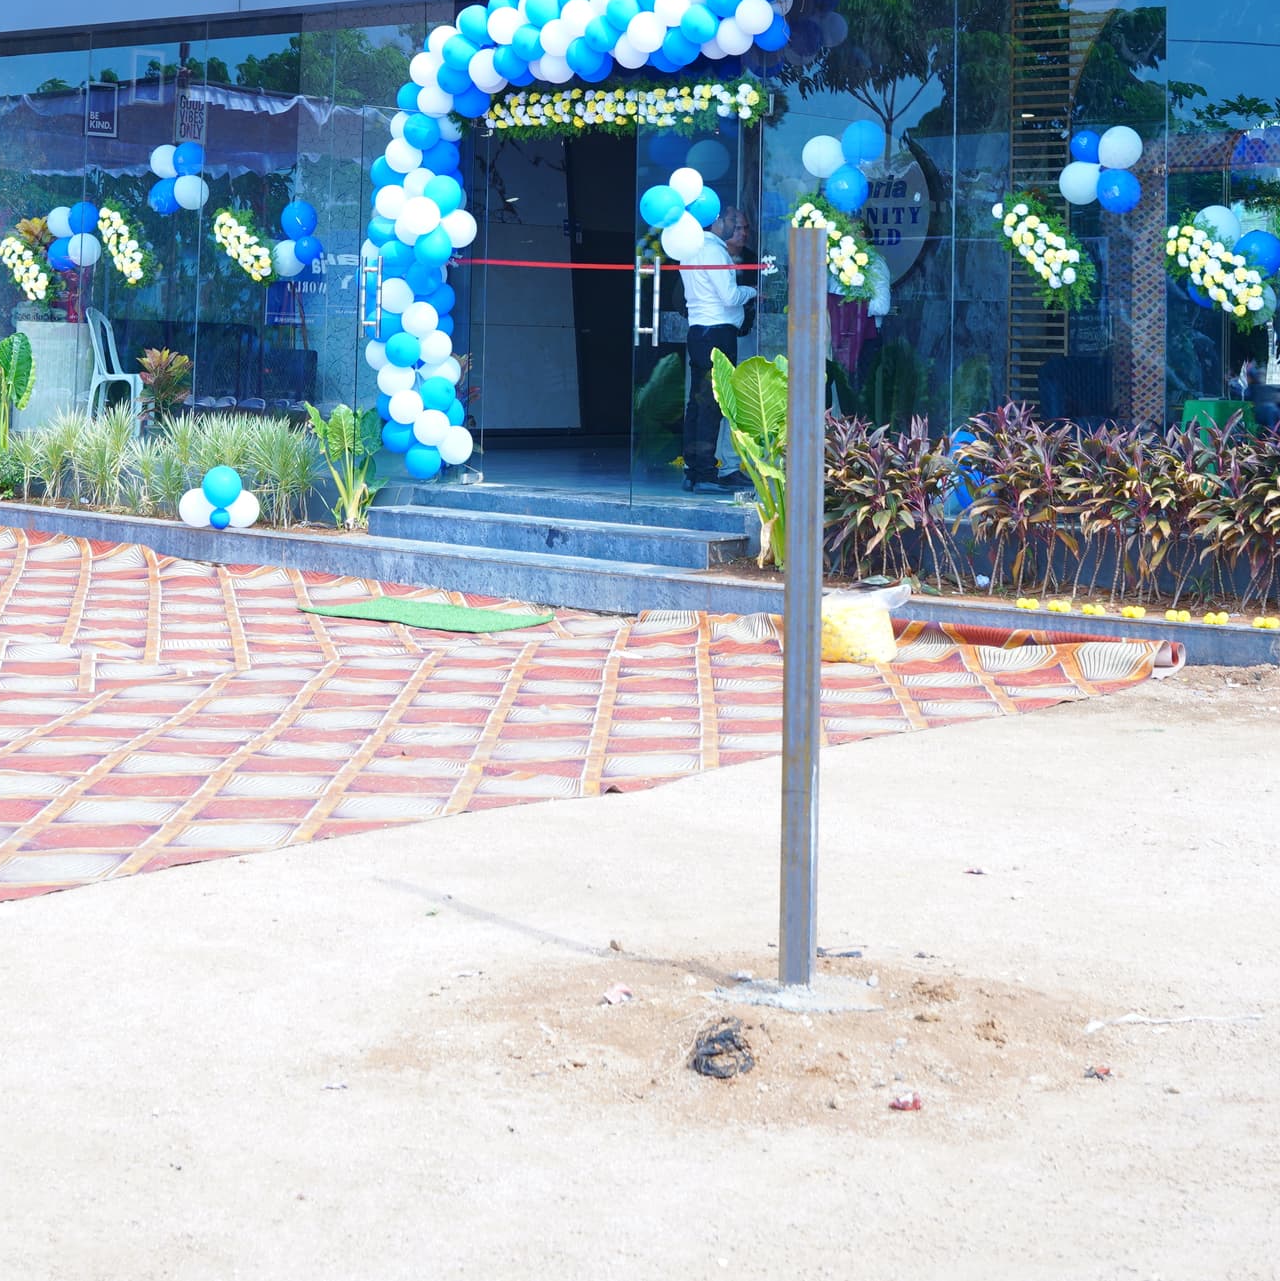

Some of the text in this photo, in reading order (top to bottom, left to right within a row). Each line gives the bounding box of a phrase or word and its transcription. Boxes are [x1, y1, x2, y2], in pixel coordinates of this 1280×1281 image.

[89, 111, 100, 120] BE
[180, 111, 204, 124] VIBES
[89, 120, 112, 130] KIND.
[180, 123, 204, 139] ONLY
